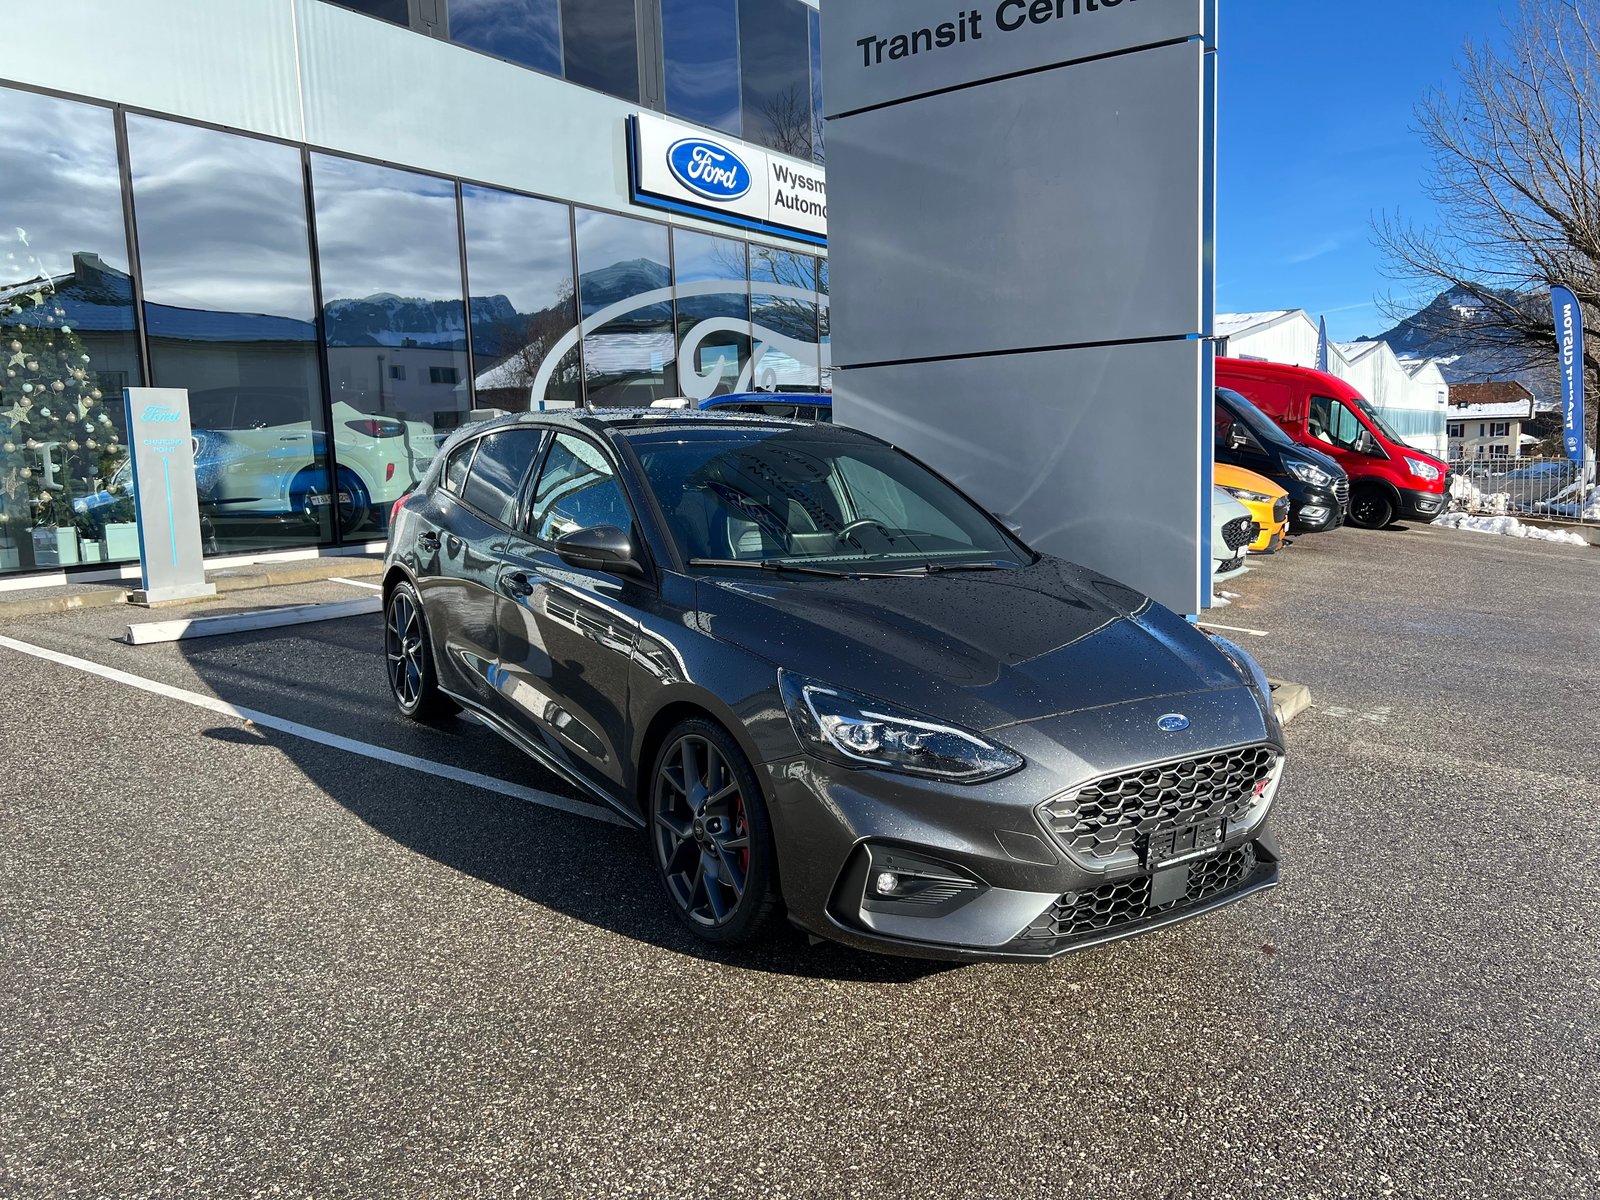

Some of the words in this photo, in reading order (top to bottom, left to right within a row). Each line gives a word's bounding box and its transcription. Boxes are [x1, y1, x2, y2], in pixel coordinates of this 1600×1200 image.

[857, 9, 983, 67] Transit
[995, 0, 1137, 32] Cen
[687, 146, 738, 190] Ford
[141, 405, 179, 422] Ford
